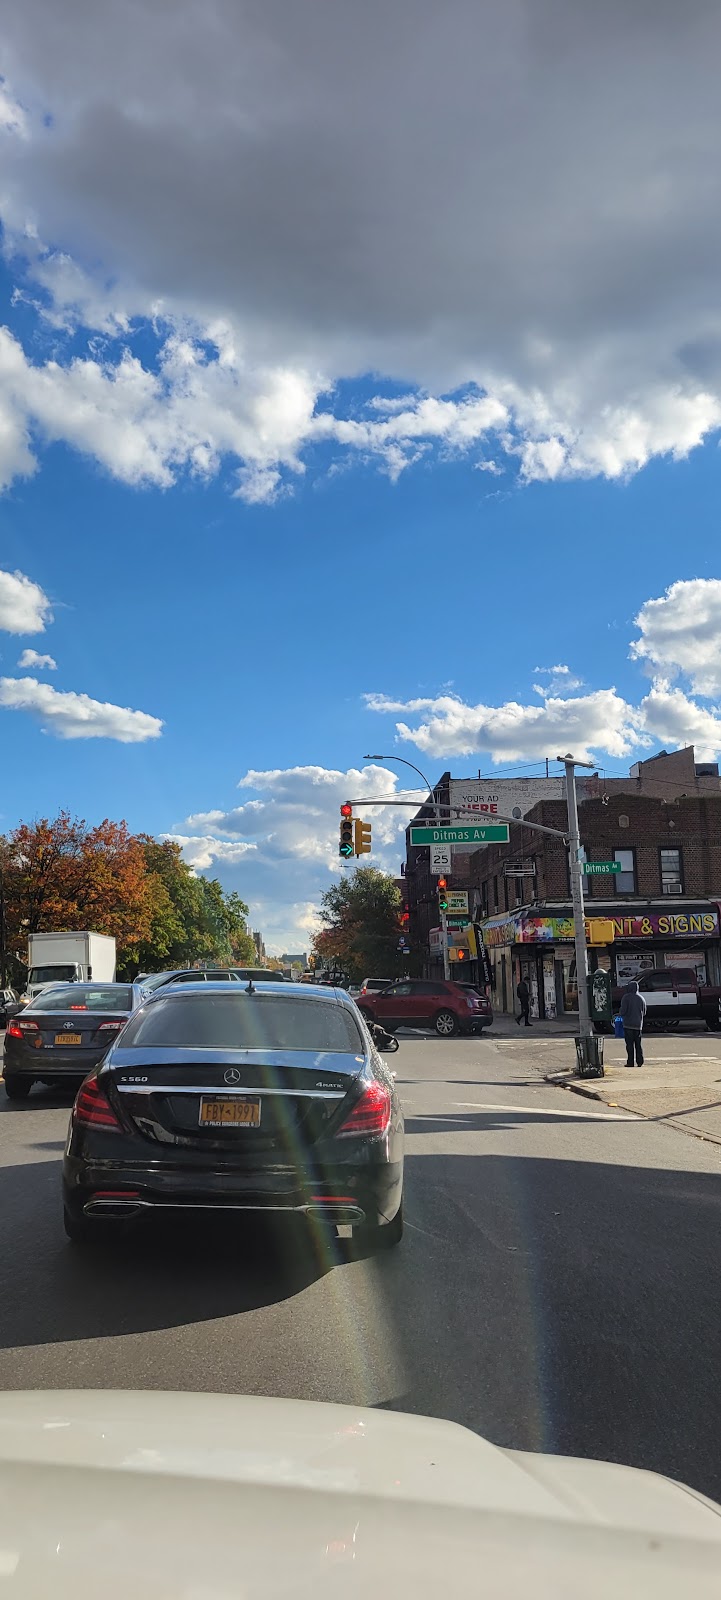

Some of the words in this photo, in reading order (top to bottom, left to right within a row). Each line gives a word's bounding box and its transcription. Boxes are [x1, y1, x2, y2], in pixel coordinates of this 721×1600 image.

[462, 795, 485, 803] YOUR
[487, 795, 499, 803] AD
[461, 803, 498, 813] HERE
[433, 830, 470, 841] Ditmas
[473, 829, 486, 840] Av
[433, 854, 449, 864] 25
[585, 863, 610, 873] Ditmas
[641, 917, 654, 934] &
[658, 914, 715, 934] SIGNS
[206, 1104, 225, 1120] FBY
[233, 1104, 255, 1121] 1991
